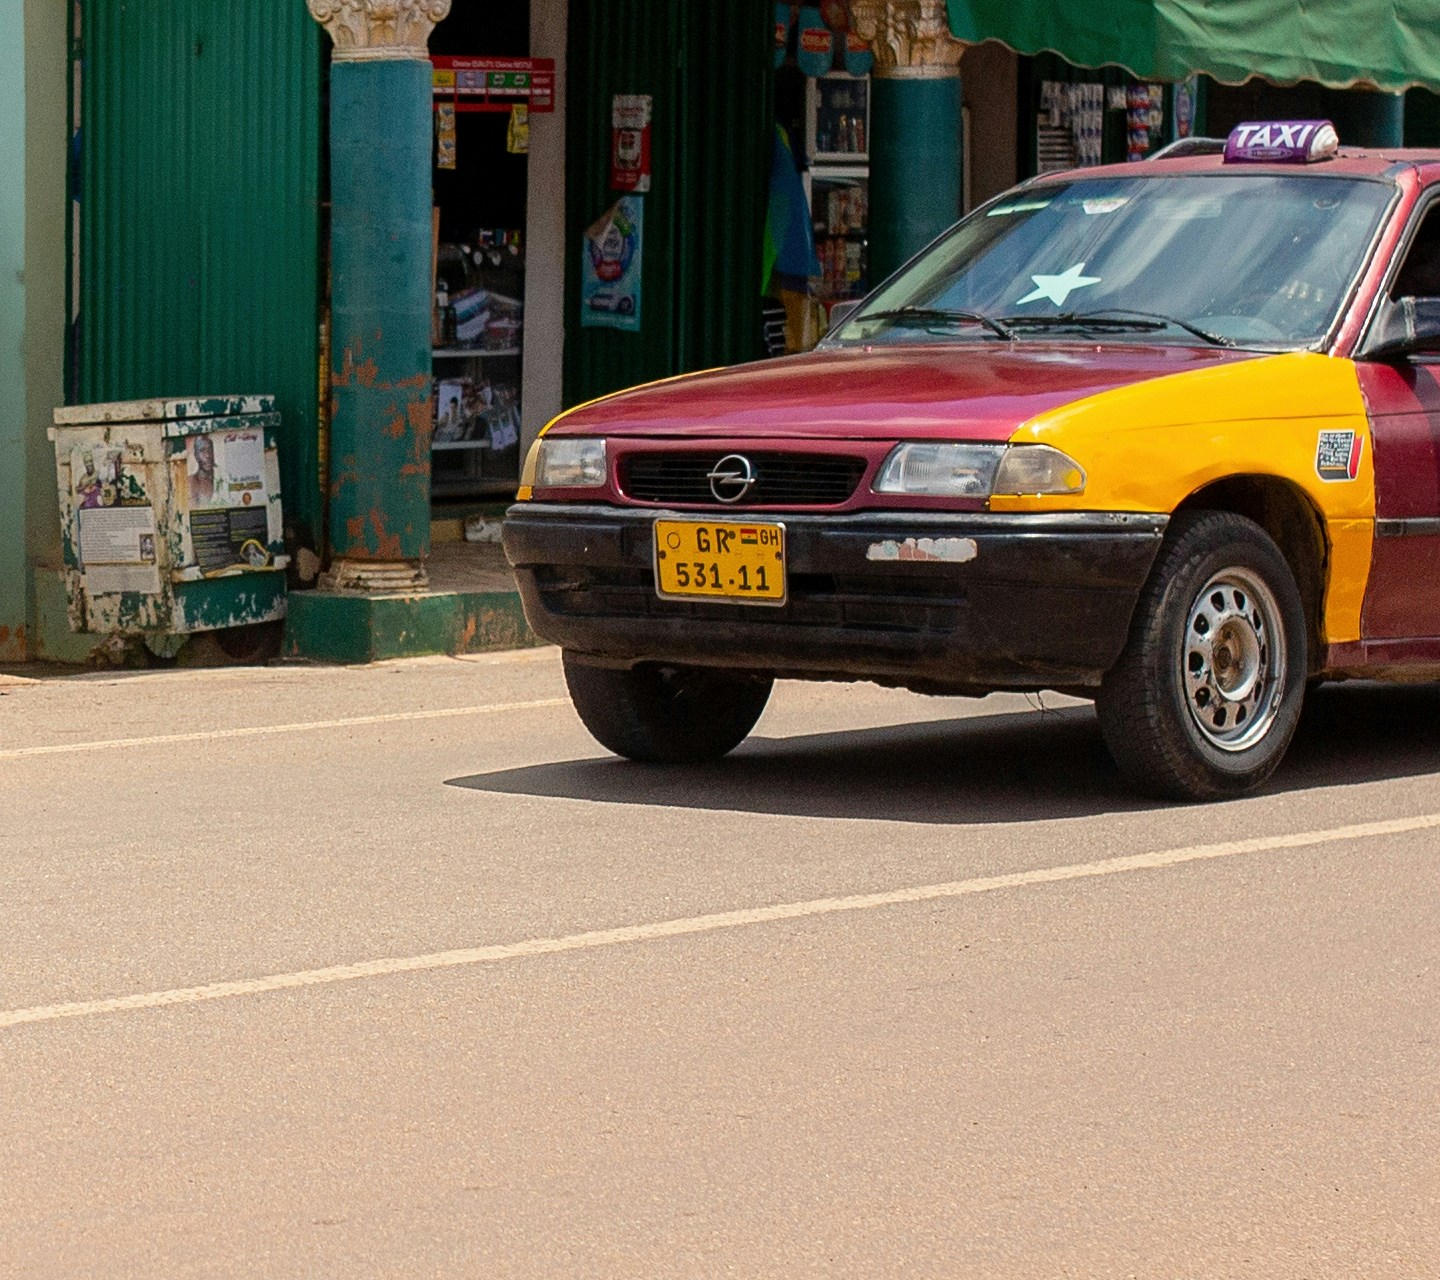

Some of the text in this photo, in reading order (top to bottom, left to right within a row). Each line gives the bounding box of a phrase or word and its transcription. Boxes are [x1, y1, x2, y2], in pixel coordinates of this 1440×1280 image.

[1236, 124, 1314, 148] TAXI
[695, 527, 779, 554] GR GH
